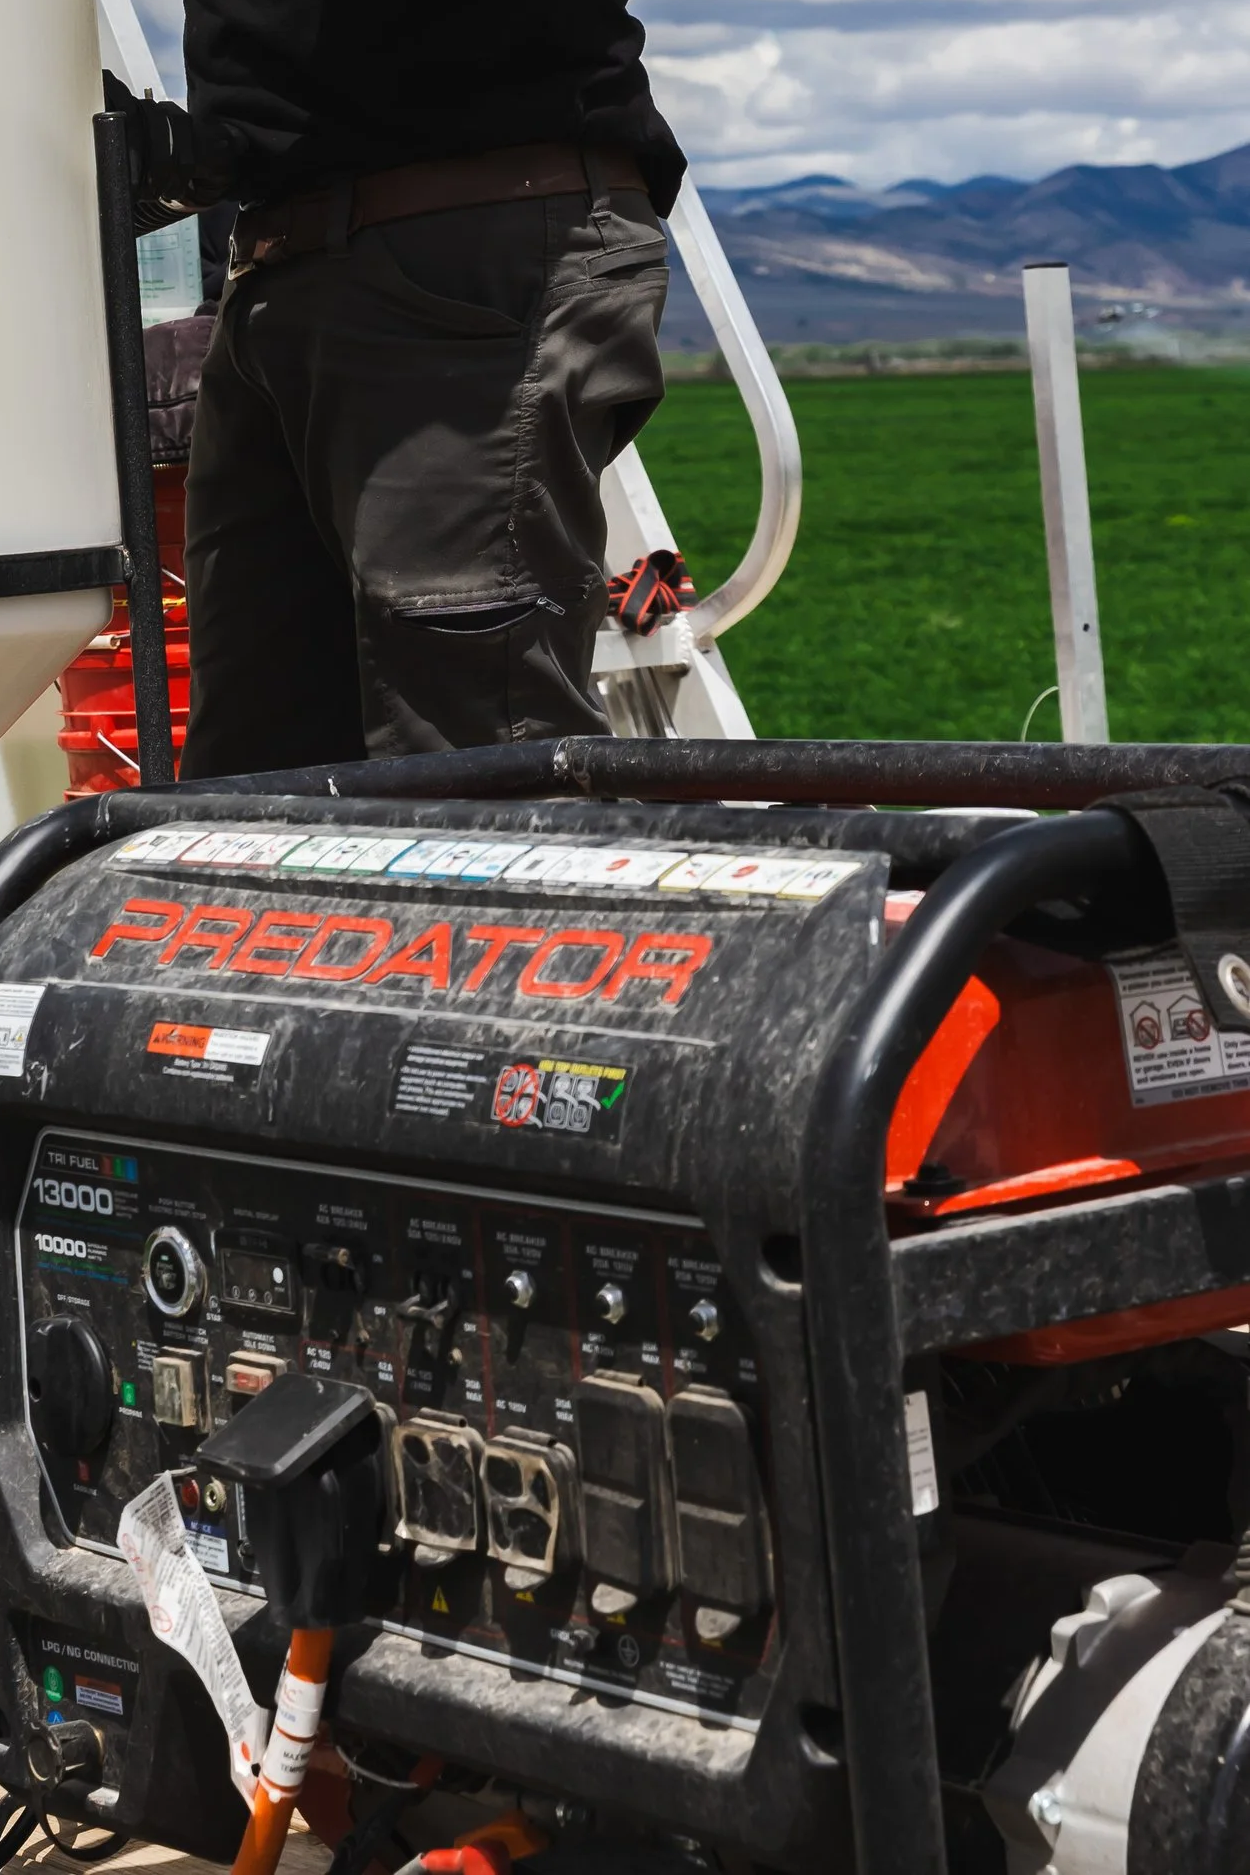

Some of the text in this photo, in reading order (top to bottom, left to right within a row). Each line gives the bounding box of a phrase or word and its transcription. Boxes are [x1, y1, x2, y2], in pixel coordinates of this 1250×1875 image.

[90, 897, 713, 1007] PREDATOR
[160, 1033, 206, 1049] WRNING
[48, 1152, 99, 1171] TRI FUEL
[33, 1177, 114, 1216] 13000
[34, 1233, 87, 1259] 10000
